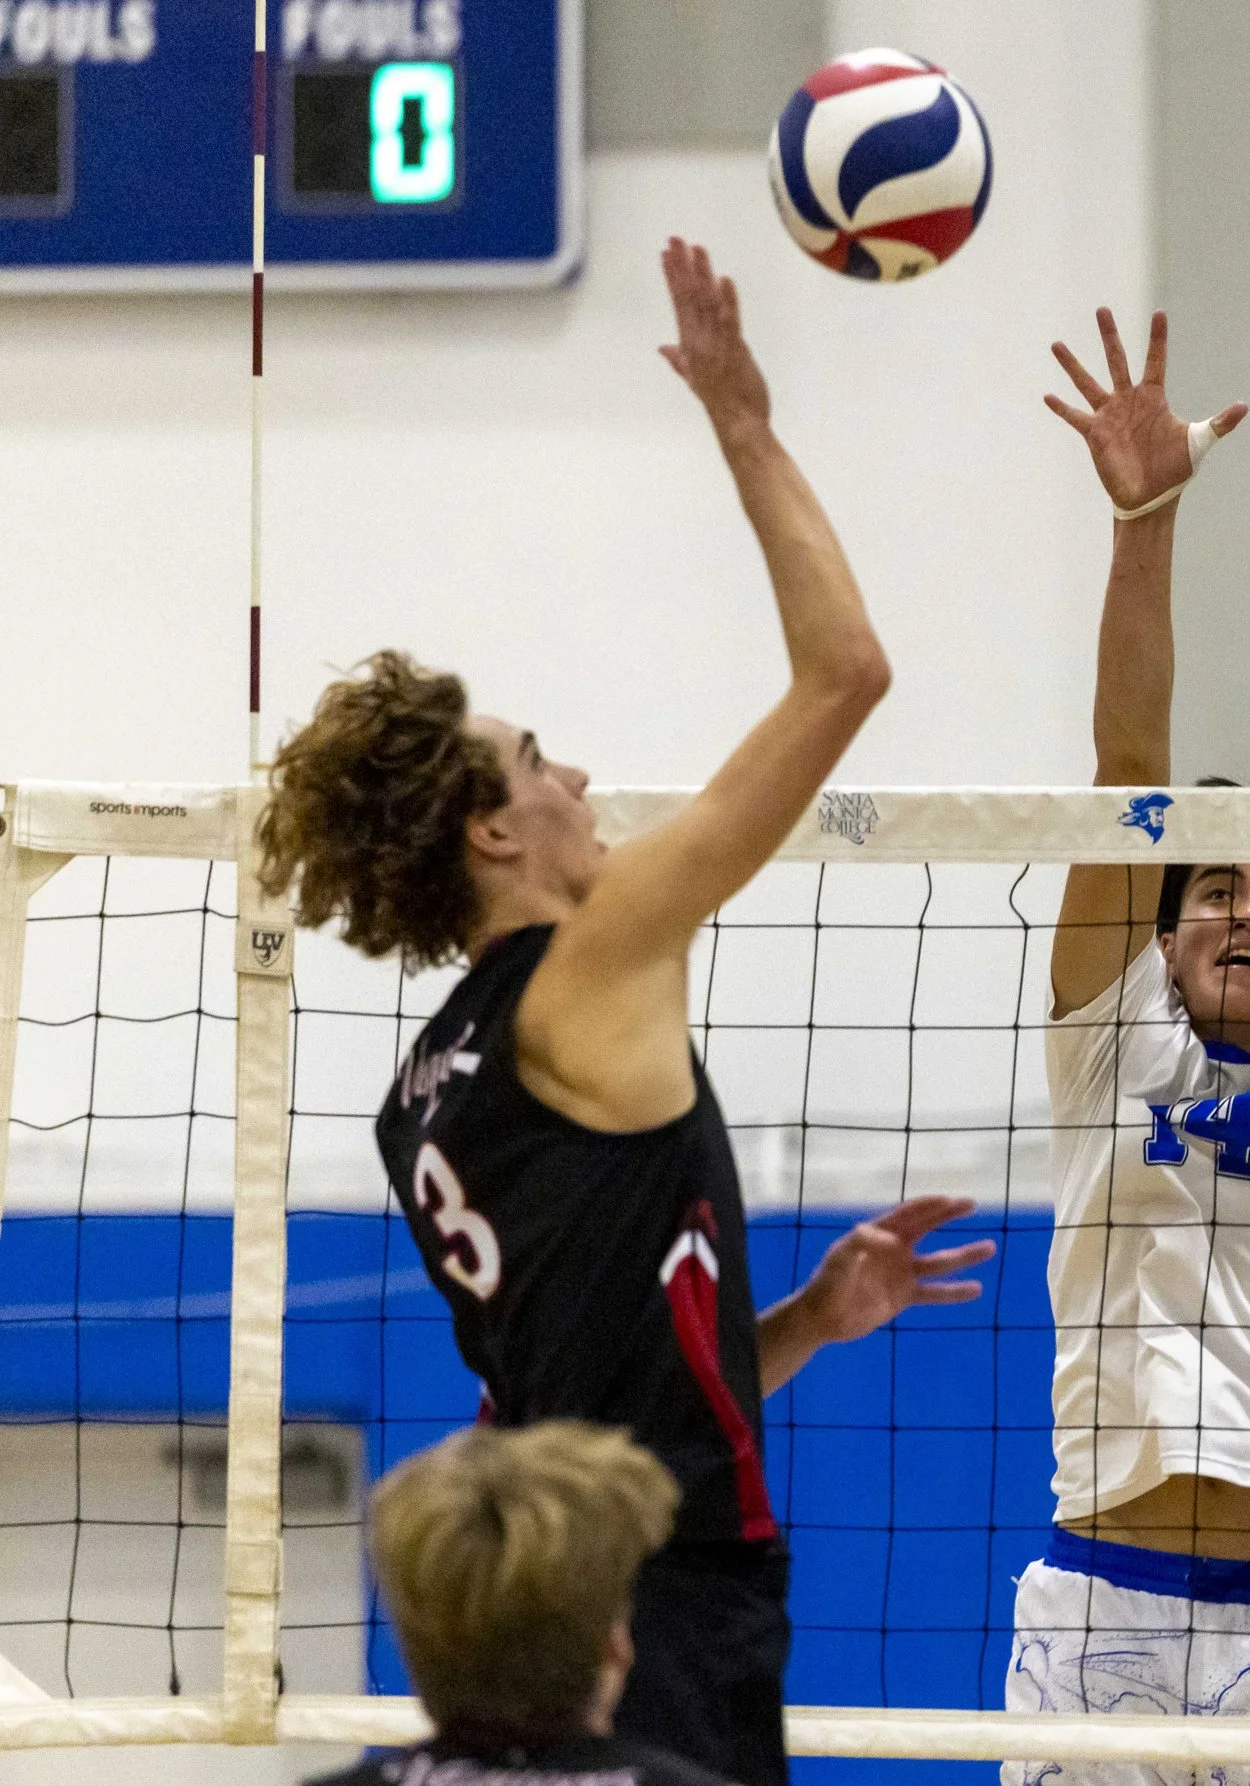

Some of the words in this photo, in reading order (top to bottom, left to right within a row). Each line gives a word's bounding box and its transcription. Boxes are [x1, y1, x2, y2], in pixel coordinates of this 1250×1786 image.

[281, 0, 462, 61] FOULS
[370, 62, 455, 203] 0
[90, 802, 132, 815] sports
[134, 804, 188, 819] imports
[818, 807, 879, 821] MONICA
[822, 792, 875, 807] SANTA
[413, 1142, 501, 1301] 3
